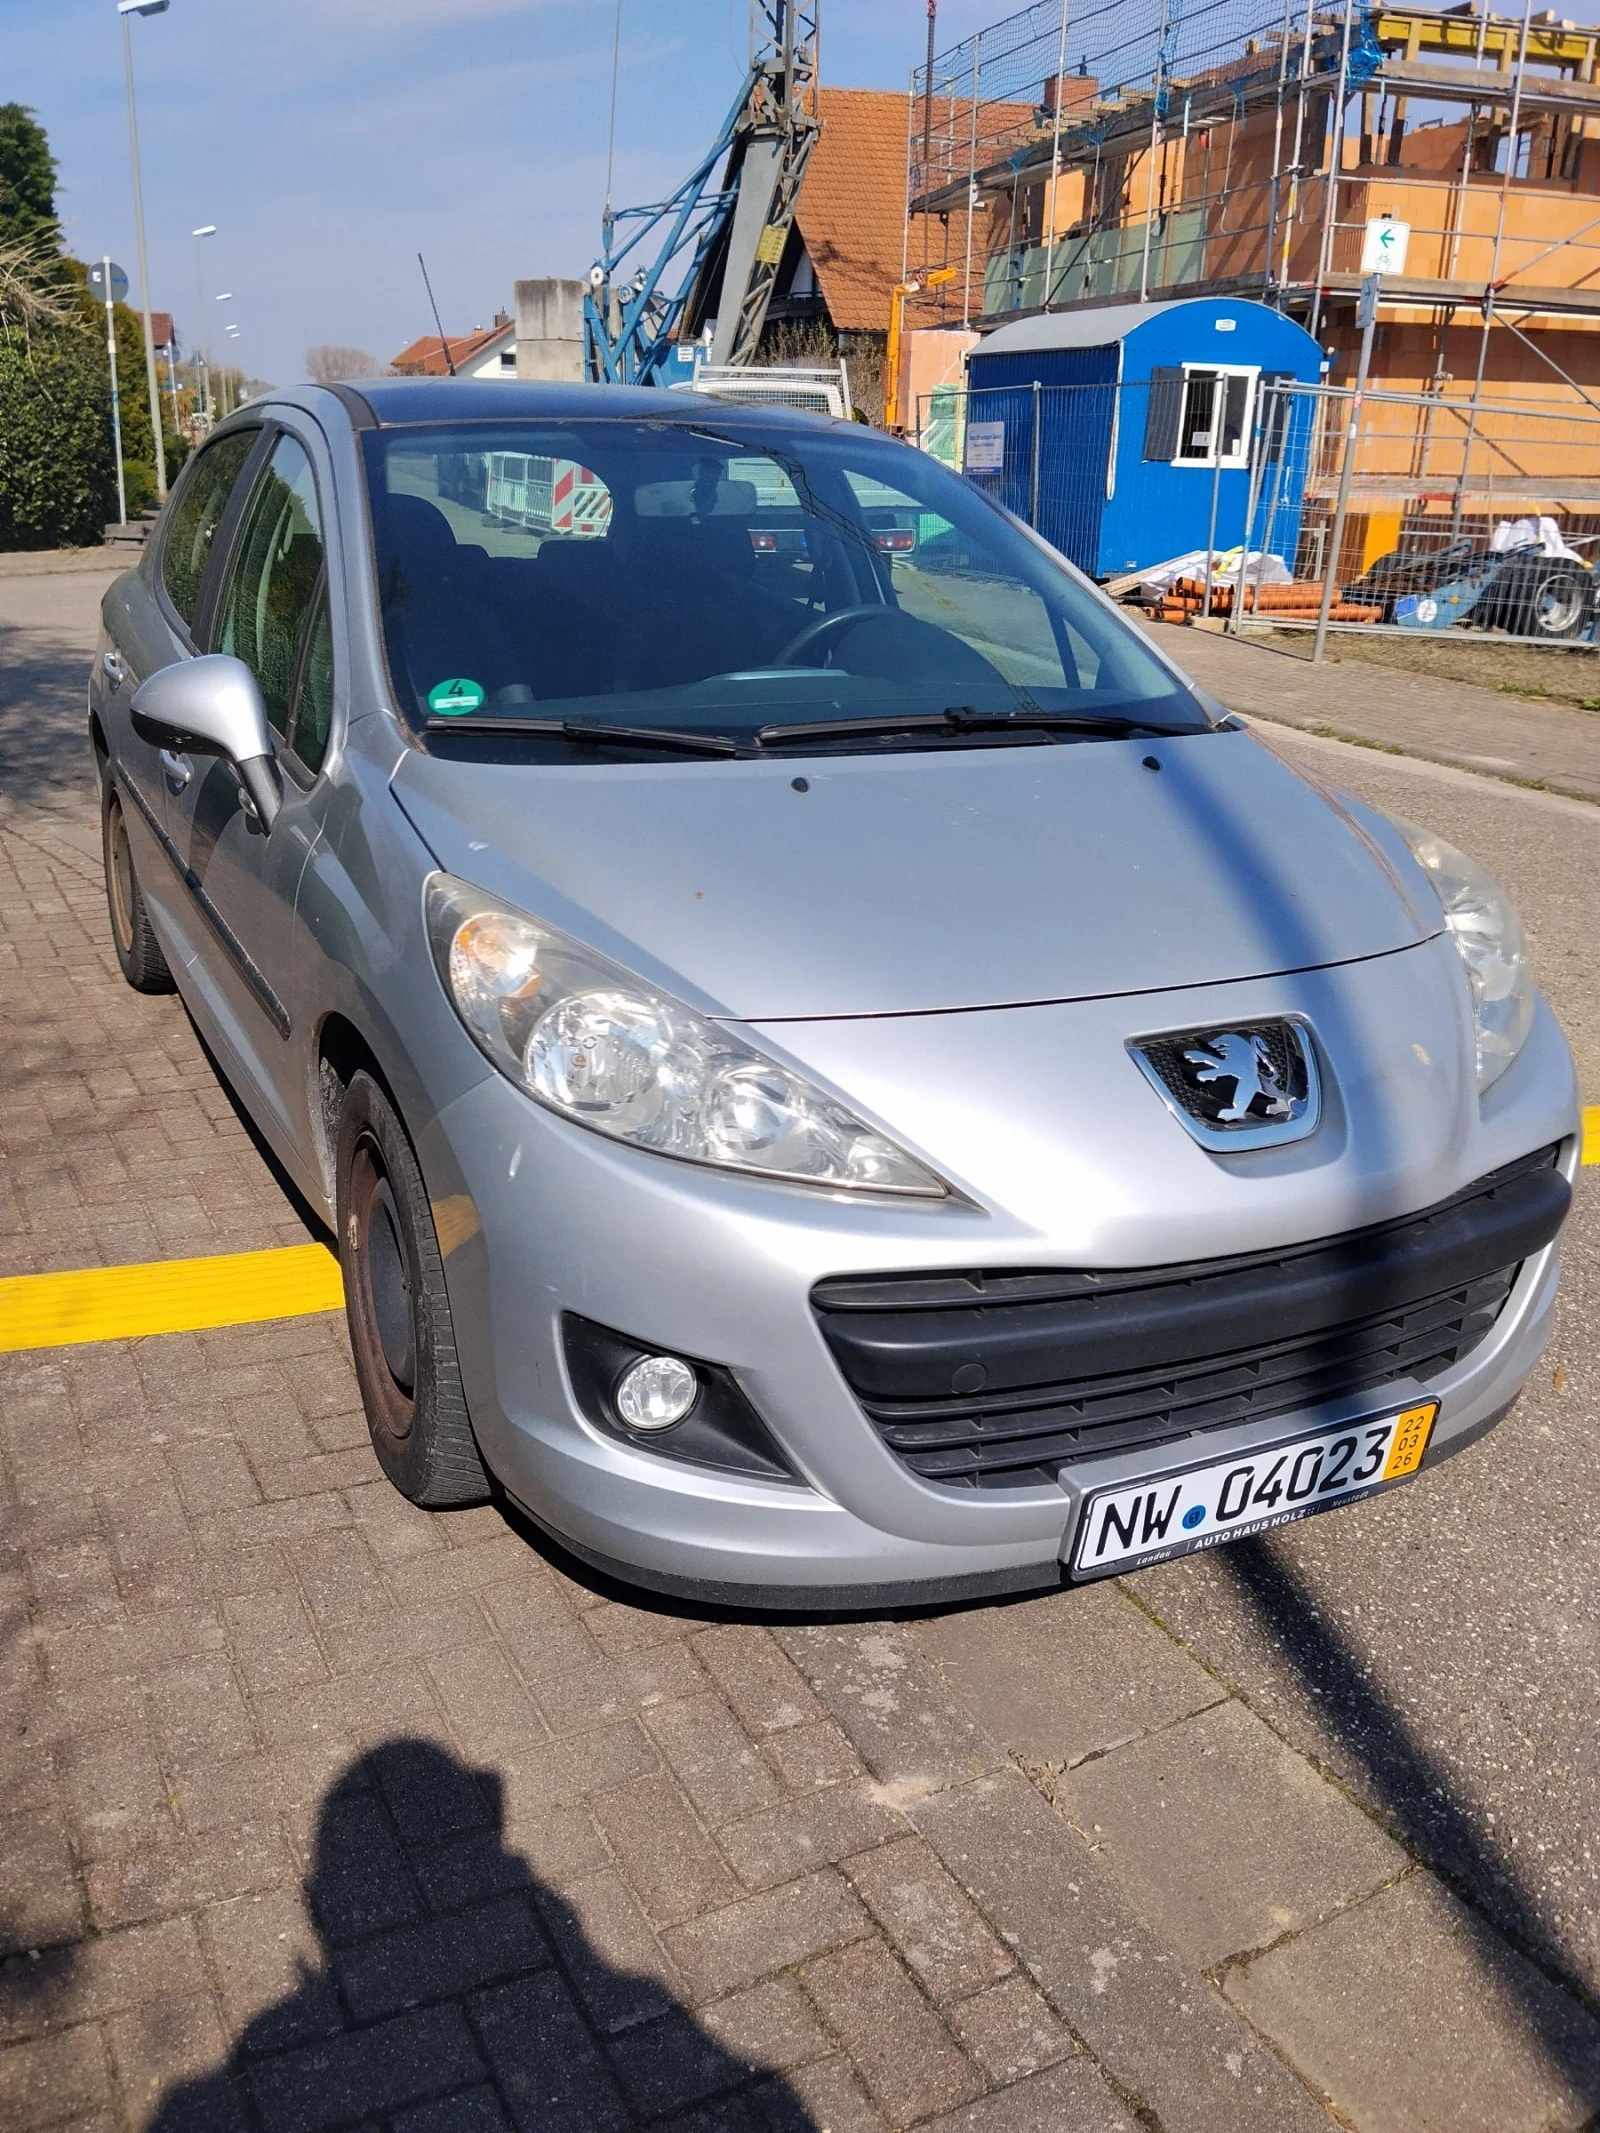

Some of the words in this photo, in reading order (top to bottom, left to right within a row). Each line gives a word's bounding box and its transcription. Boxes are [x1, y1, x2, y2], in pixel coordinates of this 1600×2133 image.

[448, 680, 464, 696] 4
[1403, 1416, 1425, 1433] 22
[1398, 1434, 1419, 1451] 03
[1392, 1452, 1413, 1470] 26
[1095, 1484, 1182, 1556] NW
[1215, 1425, 1393, 1522] 04023
[1136, 1550, 1171, 1565] Landau
[1271, 1509, 1307, 1528] HOLZ
[1331, 1490, 1369, 1508] Neustadt
